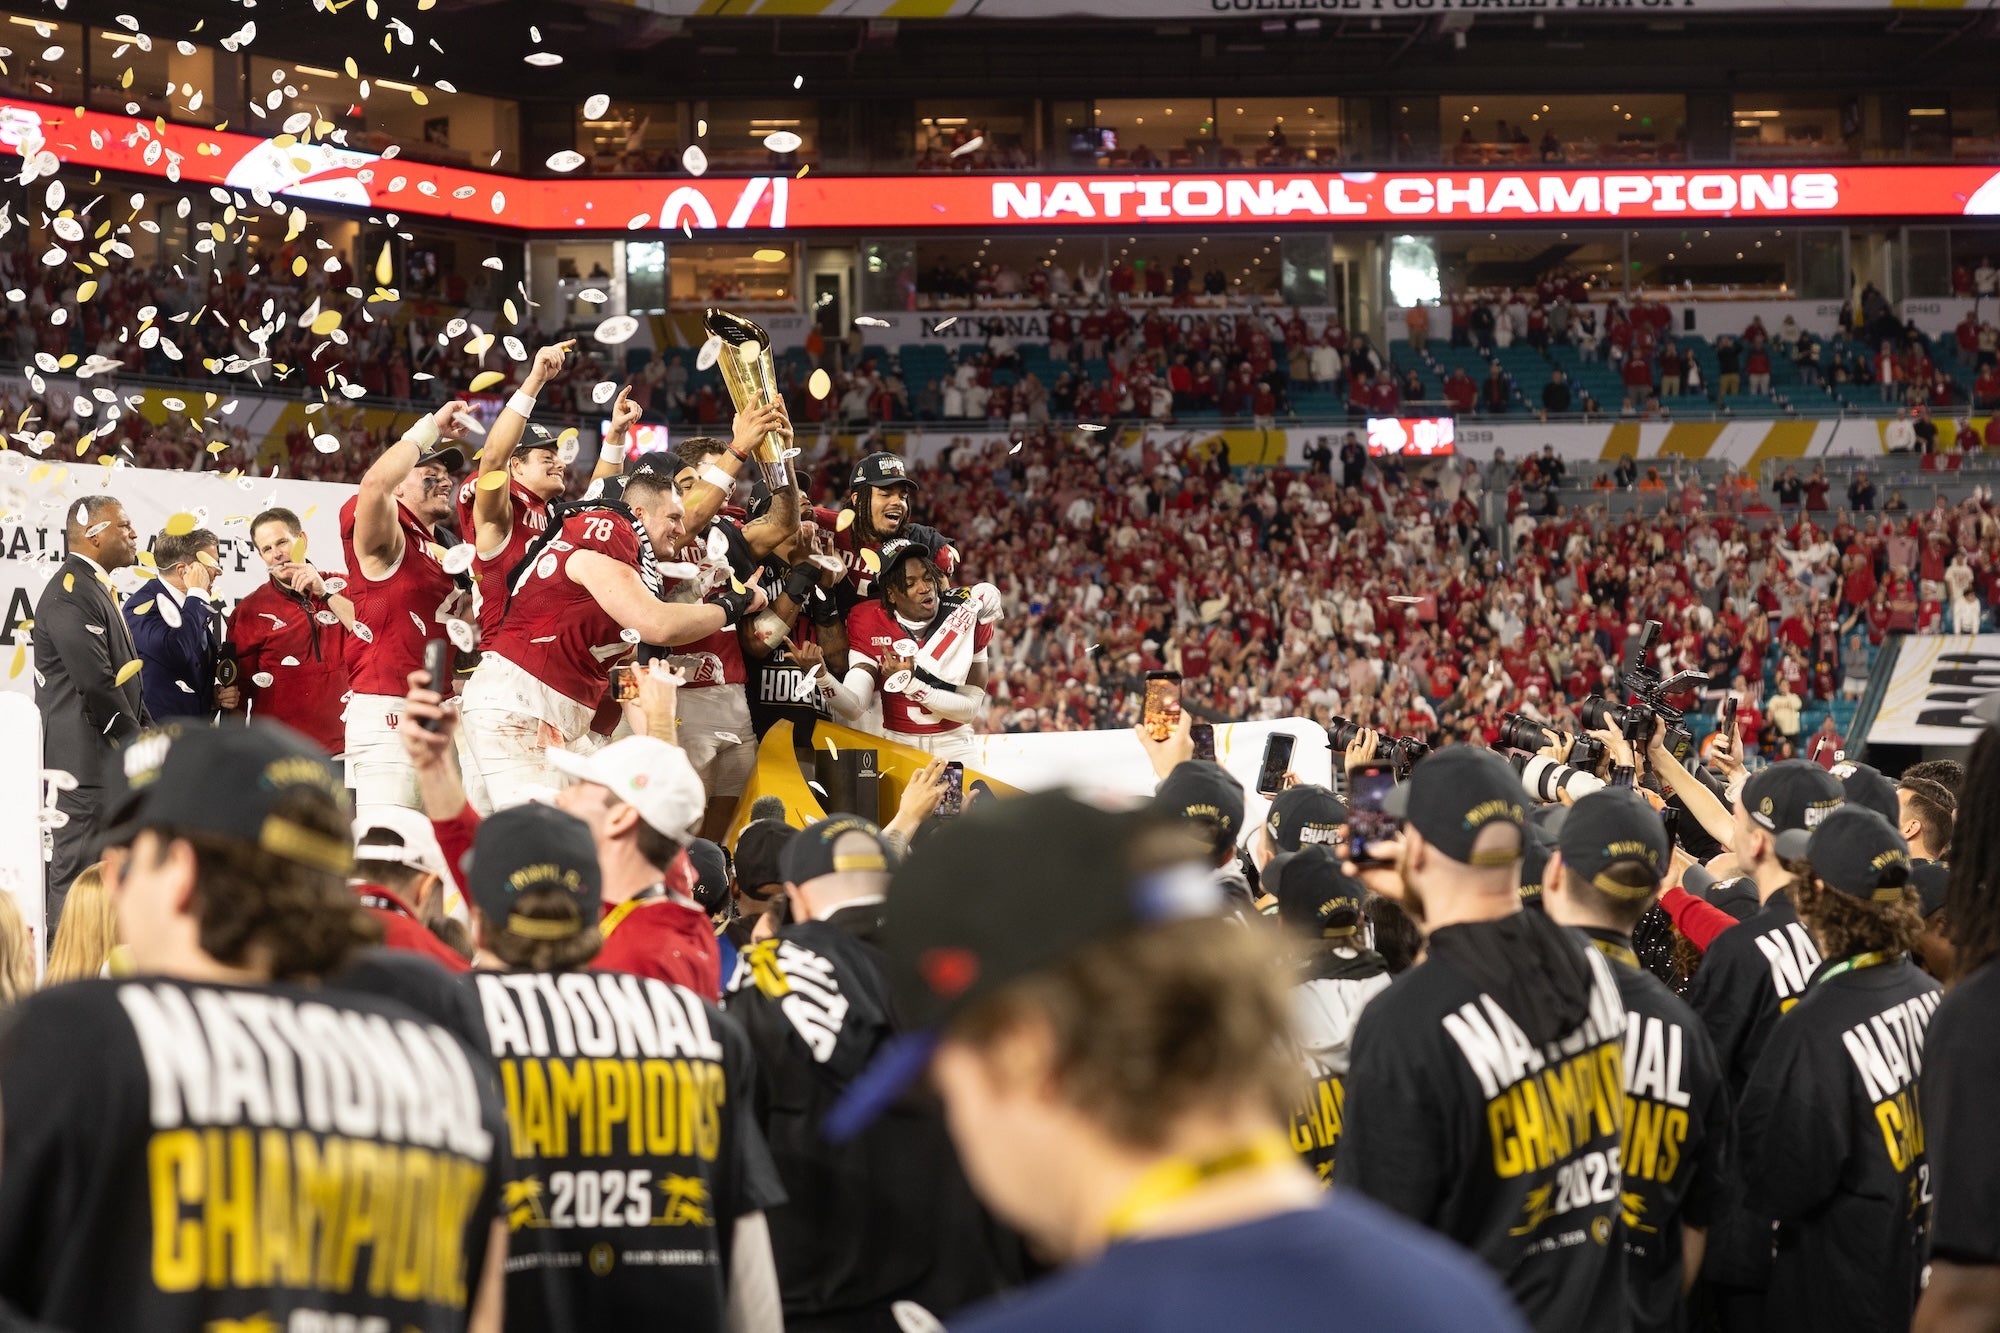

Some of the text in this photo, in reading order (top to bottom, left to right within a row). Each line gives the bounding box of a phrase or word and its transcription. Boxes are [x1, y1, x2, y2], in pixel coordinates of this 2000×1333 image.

[991, 173, 1839, 218] NATIONAL CHAMPIONS
[583, 516, 615, 542] 78
[118, 982, 495, 1162] NATIONAL
[549, 1169, 652, 1229] 2025
